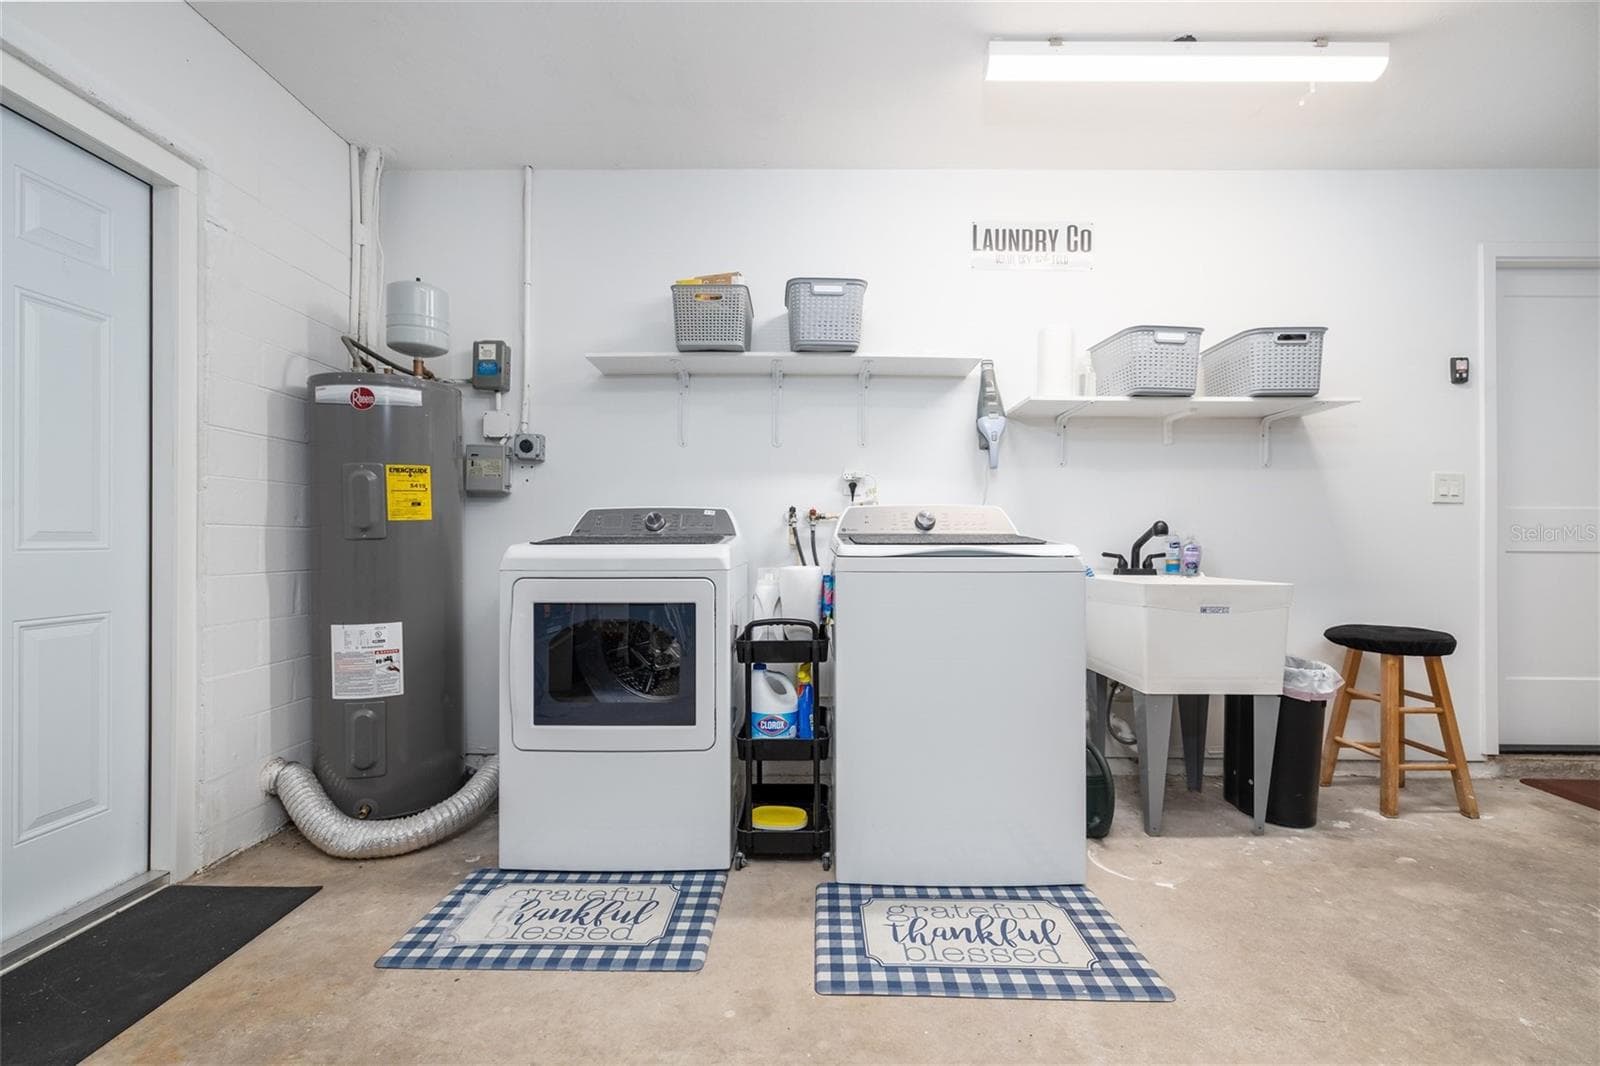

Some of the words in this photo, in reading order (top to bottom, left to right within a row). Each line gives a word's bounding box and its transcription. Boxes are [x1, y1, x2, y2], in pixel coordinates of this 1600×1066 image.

[760, 720, 785, 730] CLOROX
[886, 903, 1043, 922] grateful
[882, 914, 1061, 948] thankful
[902, 943, 1068, 964] blessed
